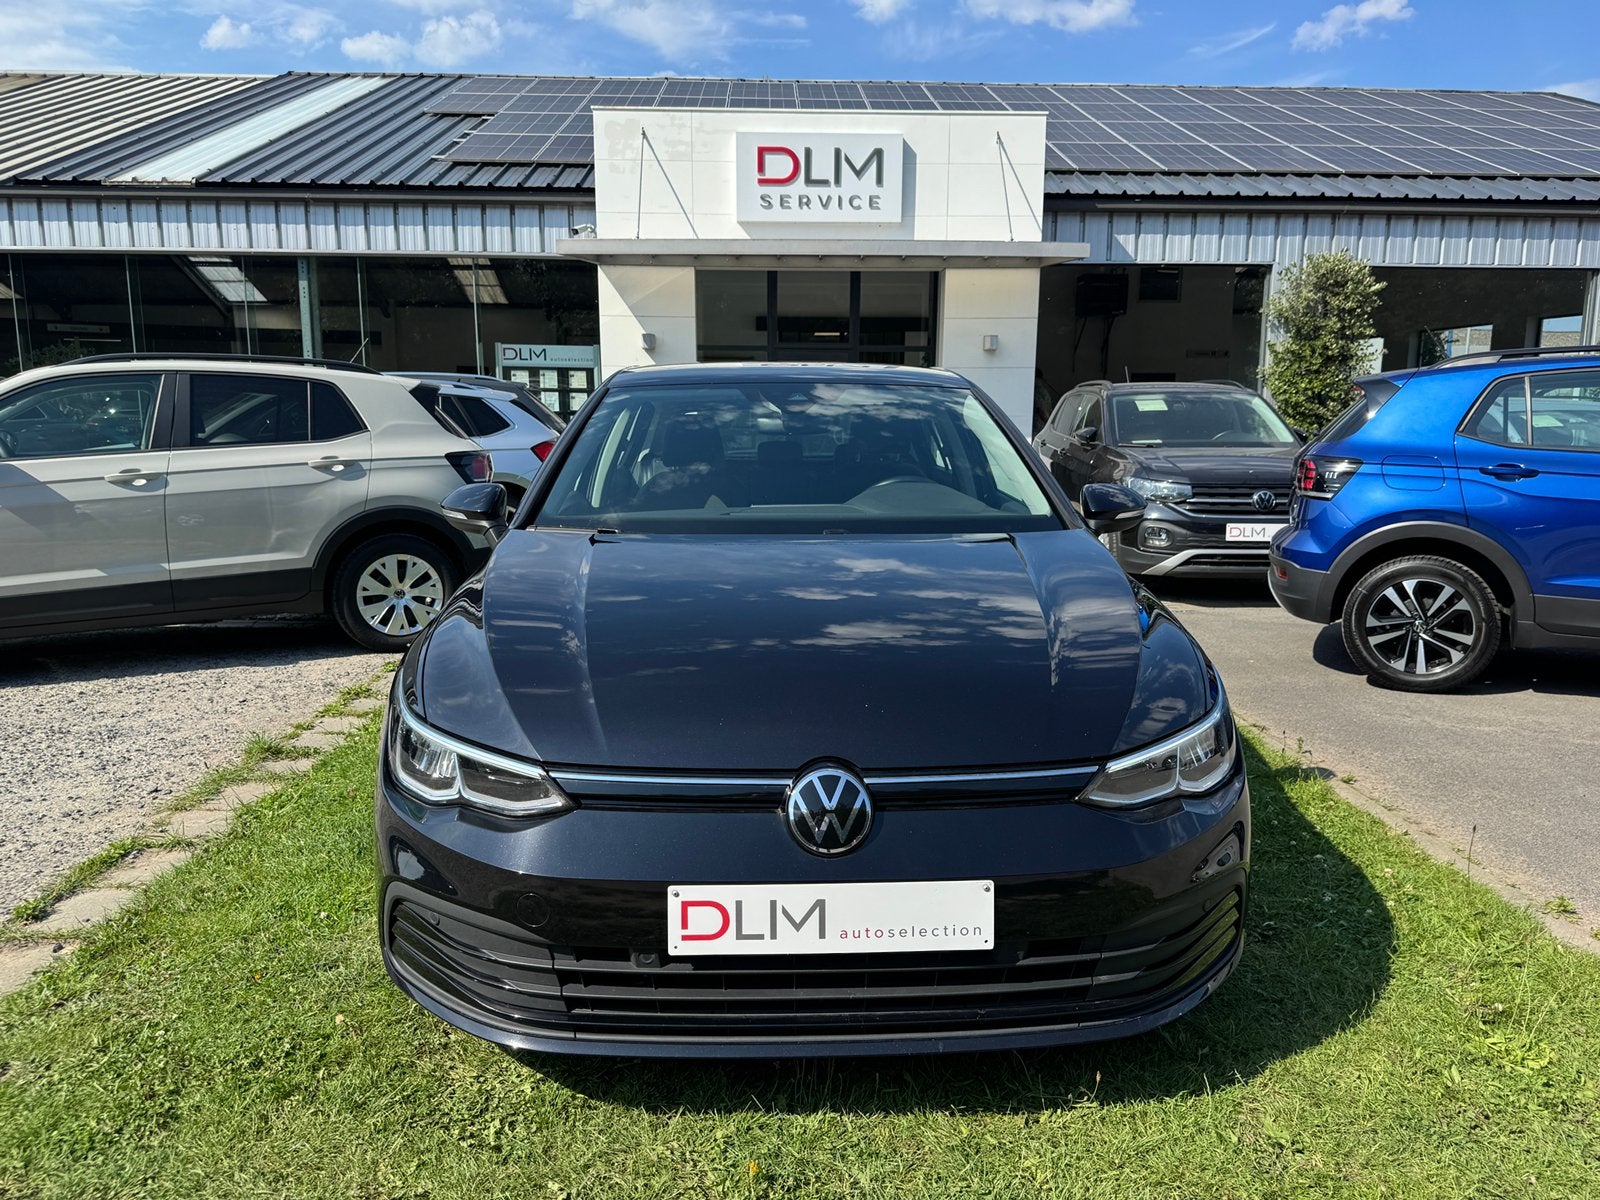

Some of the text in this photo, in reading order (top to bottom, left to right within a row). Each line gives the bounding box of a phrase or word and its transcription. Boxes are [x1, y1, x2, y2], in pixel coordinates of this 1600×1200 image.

[757, 146, 884, 187] DLM
[760, 194, 881, 210] SERVICE
[503, 348, 547, 361] DLM
[1229, 527, 1266, 538] DLM
[681, 899, 982, 941] DLM autoselection
